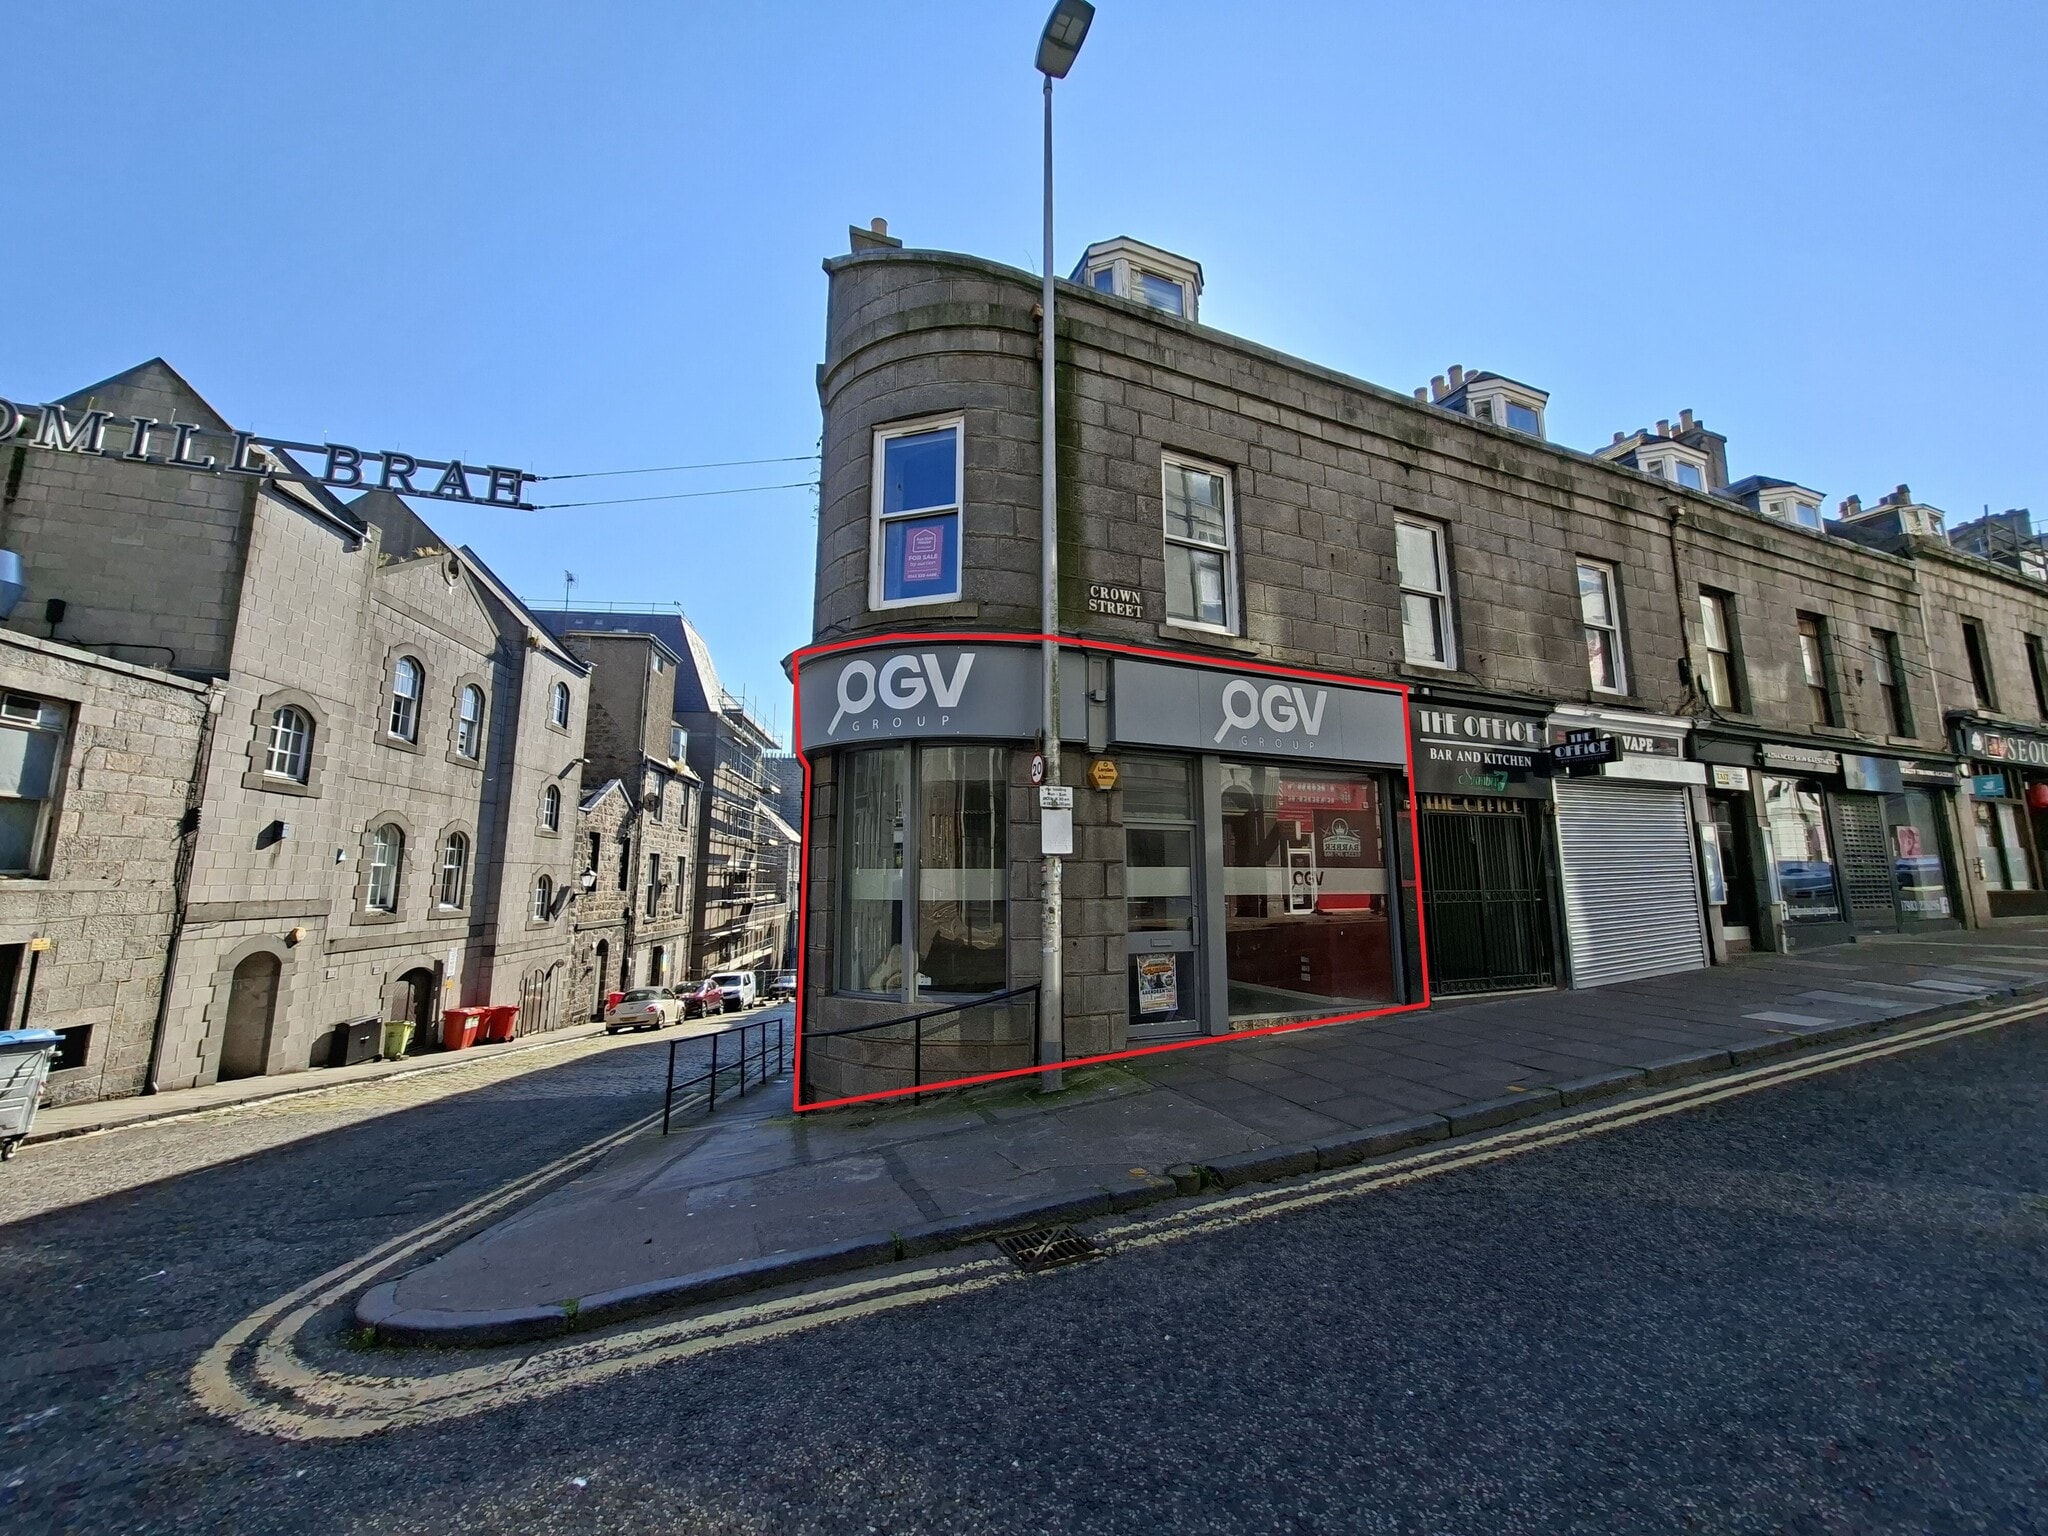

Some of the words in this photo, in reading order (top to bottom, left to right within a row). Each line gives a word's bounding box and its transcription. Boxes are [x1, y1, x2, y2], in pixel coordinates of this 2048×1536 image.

[318, 442, 523, 508] BRAE
[922, 553, 938, 561] SALE
[1090, 585, 1141, 604] CROWN
[1088, 598, 1143, 618] STREET
[852, 715, 950, 732] GROUP
[1418, 710, 1459, 736] THE
[1463, 715, 1539, 744] OFFICE
[1241, 735, 1315, 751] GROUP
[1569, 731, 1593, 744] THE
[1622, 735, 1654, 753] VAPE
[1429, 747, 1453, 761] BAR
[1456, 751, 1482, 764] AND
[1484, 752, 1533, 768] KITCHEN
[1554, 739, 1611, 758] OFFICE
[1032, 762, 1042, 777] 20
[1493, 769, 1509, 792] 7
[1426, 795, 1459, 811] THE
[1463, 796, 1524, 814] OFFICE
